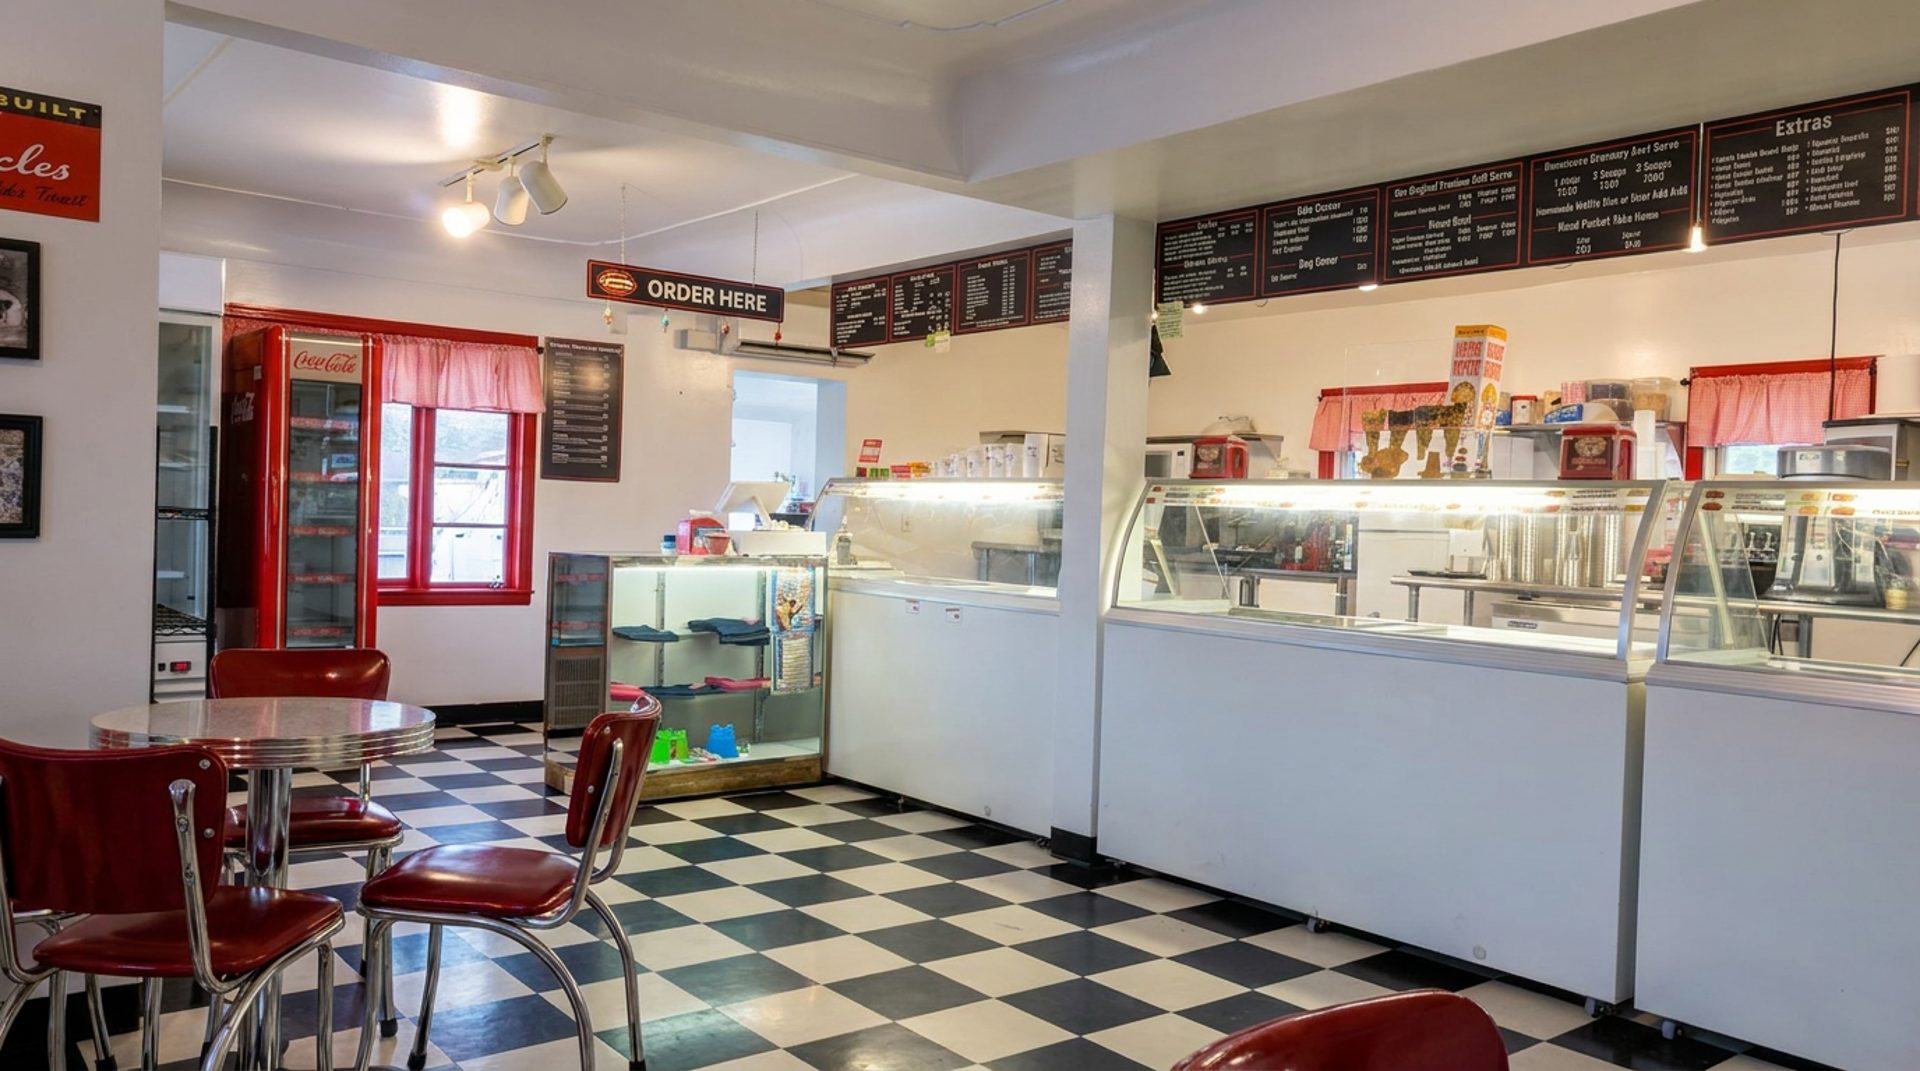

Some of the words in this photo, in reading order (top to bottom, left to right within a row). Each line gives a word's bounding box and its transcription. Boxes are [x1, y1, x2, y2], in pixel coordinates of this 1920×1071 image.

[1775, 115, 1833, 137] Extras
[648, 279, 715, 306] ORDER
[719, 290, 767, 312] HERE
